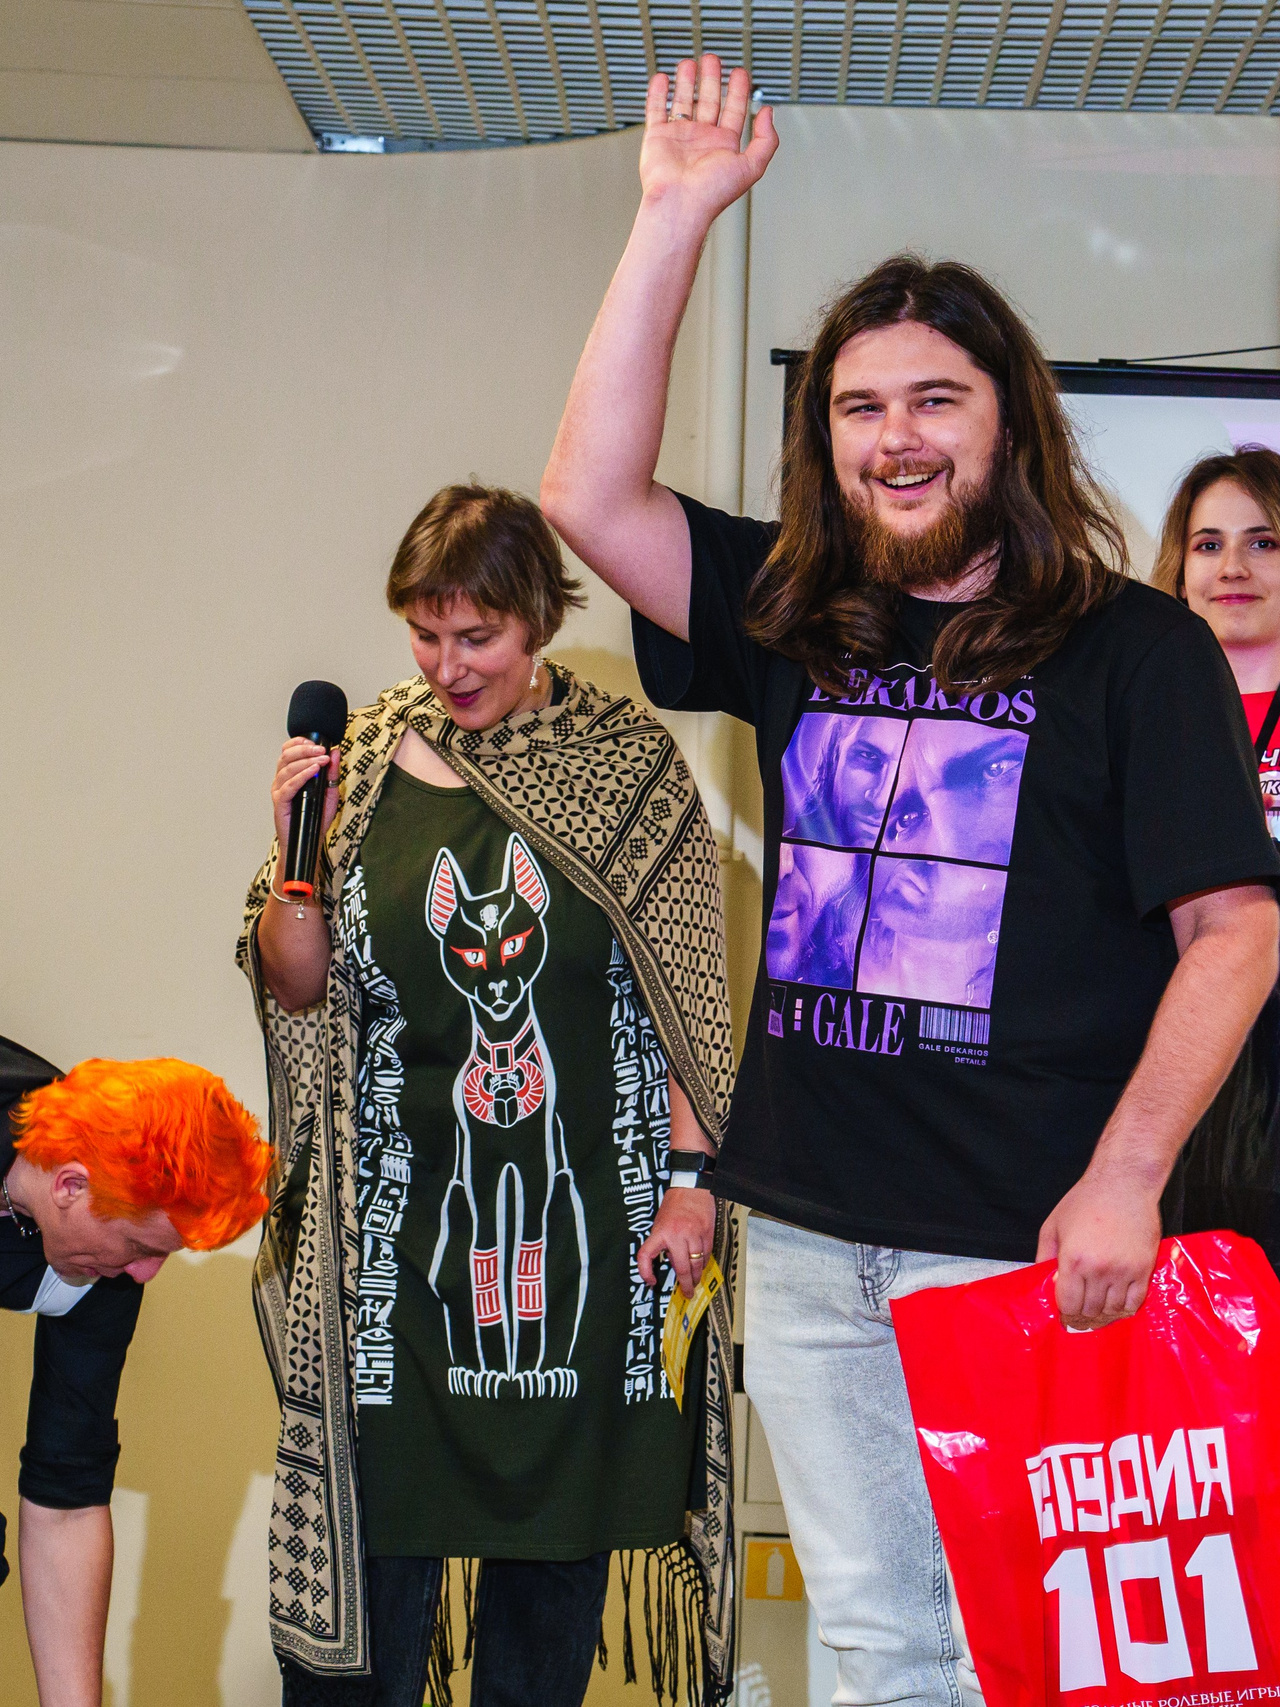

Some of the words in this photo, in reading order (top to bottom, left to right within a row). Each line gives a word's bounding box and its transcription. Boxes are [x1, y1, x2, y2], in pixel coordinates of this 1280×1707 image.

[813, 992, 906, 1056] GALE
[919, 1043, 941, 1052] GALE
[944, 1045, 989, 1057] DEKARIOS
[954, 1056, 987, 1066] DETAILS
[1025, 1425, 1235, 1544] СТУДИЯ
[1043, 1534, 1259, 1693] 101
[1158, 1691, 1235, 1707] РОЛЕВЫЕ
[1237, 1686, 1280, 1702] ИГРЫ
